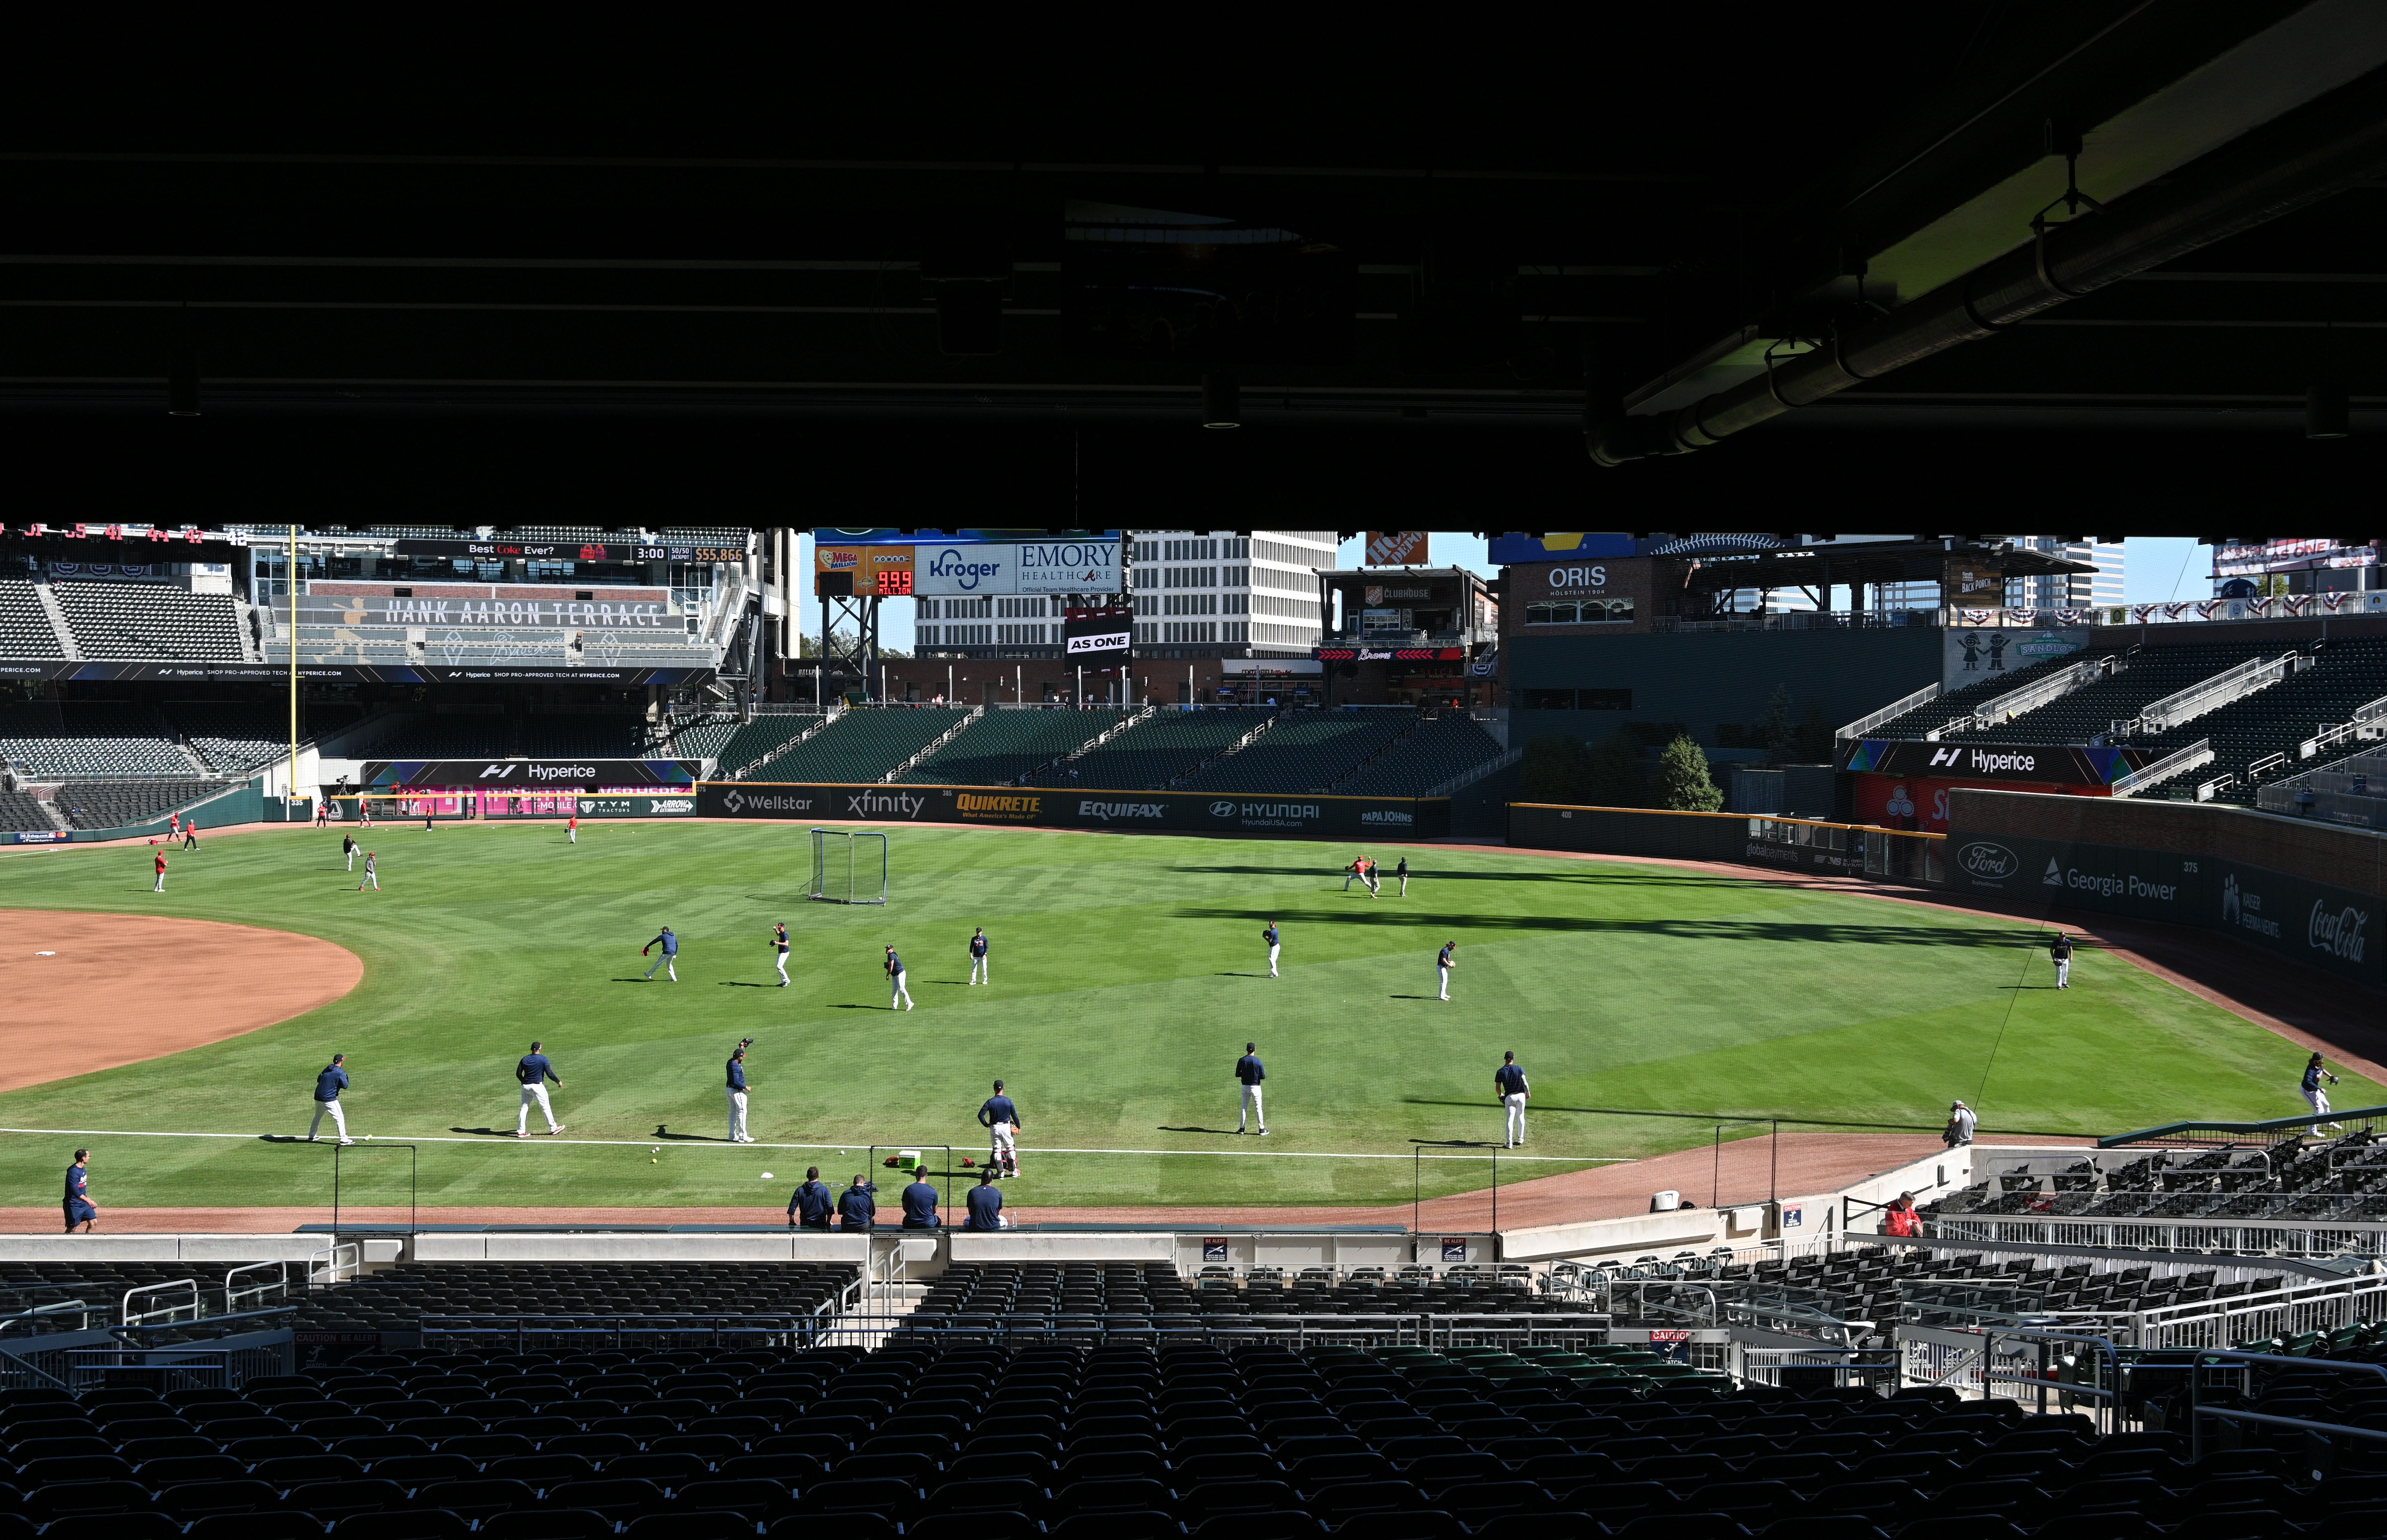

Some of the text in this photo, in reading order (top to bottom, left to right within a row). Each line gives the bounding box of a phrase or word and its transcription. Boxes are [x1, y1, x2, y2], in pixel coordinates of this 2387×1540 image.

[105, 525, 123, 540] 41
[147, 528, 169, 542] 44
[184, 529, 204, 544] 47
[226, 531, 247, 546] 42
[469, 544, 554, 555] Best Coke Ever?
[638, 548, 664, 559] 3:00
[696, 548, 743, 561] $55,866
[1021, 545, 1116, 567] EMORY
[2270, 541, 2326, 563] AS ONE
[833, 552, 858, 563] MEGA
[930, 549, 1000, 590] Kroger
[1022, 569, 1111, 582] HEALTHCARE
[1549, 566, 1606, 587] ORIS
[879, 572, 912, 587] 999
[1962, 578, 1990, 593] BACK PORCH
[1384, 589, 1428, 598] CLUBHOUSE
[386, 600, 661, 626] HANK AARON TERRACE
[1071, 636, 1126, 650] AS ONE
[1358, 648, 1391, 661] Braves
[1972, 749, 2034, 772] Hyperice
[529, 764, 595, 780] Hyperice
[661, 800, 687, 808] ARROW
[748, 795, 812, 810] Wellstar
[848, 789, 925, 818] xfinity
[957, 794, 1042, 812] QUIKRETE
[1079, 801, 1165, 821] EQUIFAX
[1242, 804, 1319, 818] HYUNDAI
[1362, 811, 1412, 822] PAPA JOHNS
[1747, 843, 1798, 862] globalpayments
[1968, 846, 2008, 874] Ford
[2184, 862, 2198, 873] 375
[2068, 868, 2177, 900] Georgia Power
[2243, 892, 2261, 910] KAISER
[2243, 913, 2279, 938] PERMANENTE
[2309, 899, 2368, 963] Coca-Cola
[296, 1334, 335, 1342] CAUTION
[1653, 1330, 1689, 1340] CAUTION
